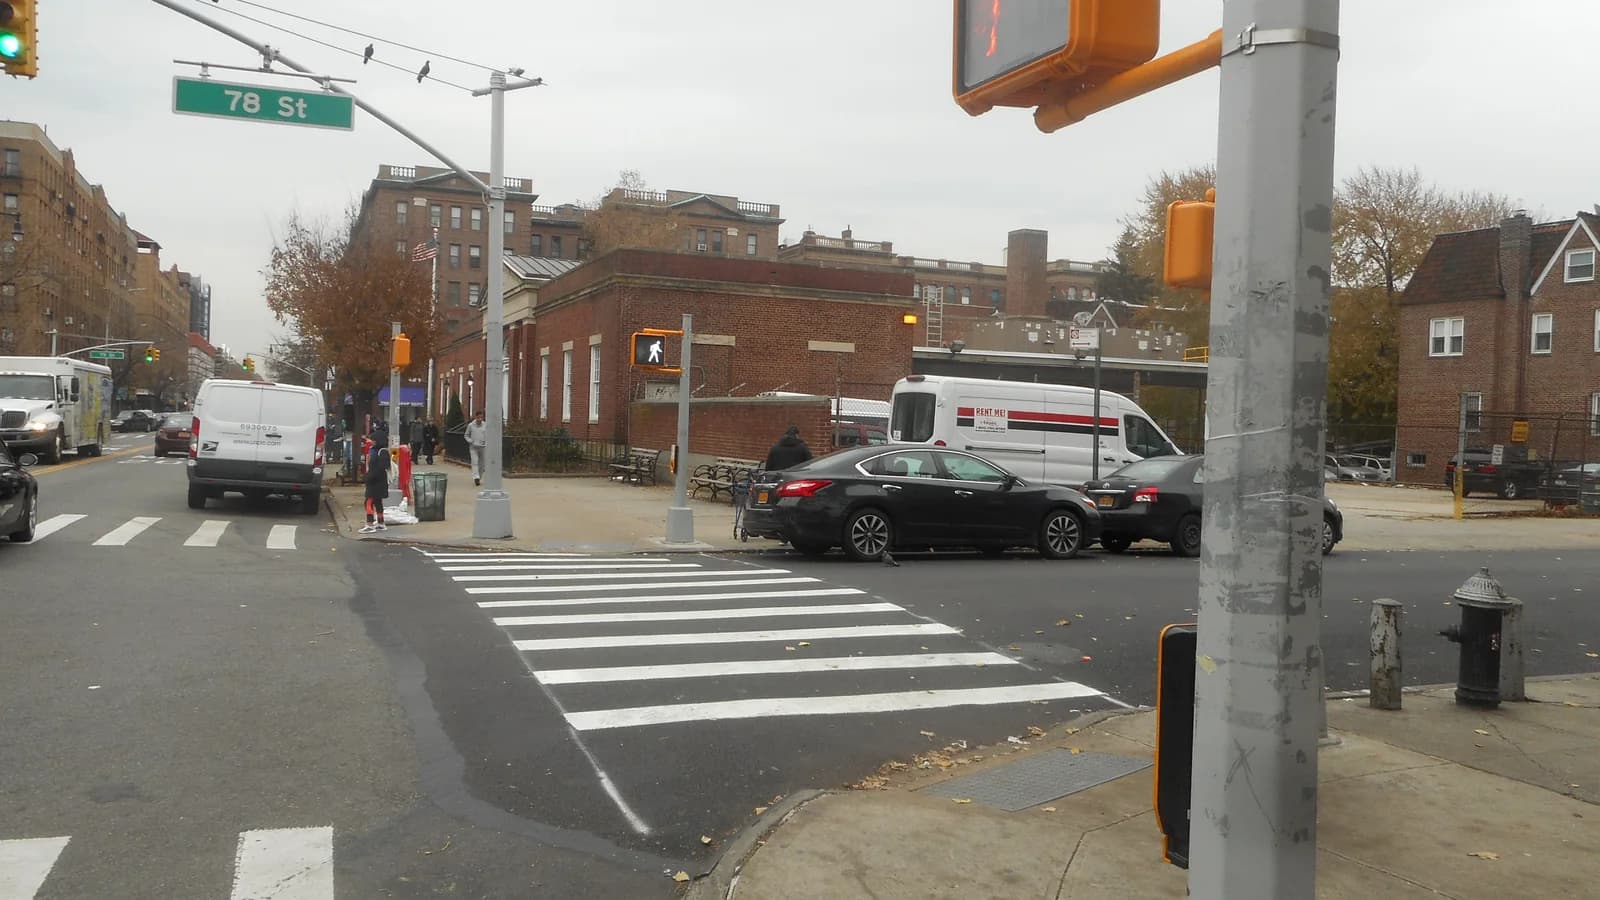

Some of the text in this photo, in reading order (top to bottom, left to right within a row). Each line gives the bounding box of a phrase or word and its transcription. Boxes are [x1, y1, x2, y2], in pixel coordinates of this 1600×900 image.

[224, 89, 308, 119] 78 St
[976, 407, 992, 417] RENT
